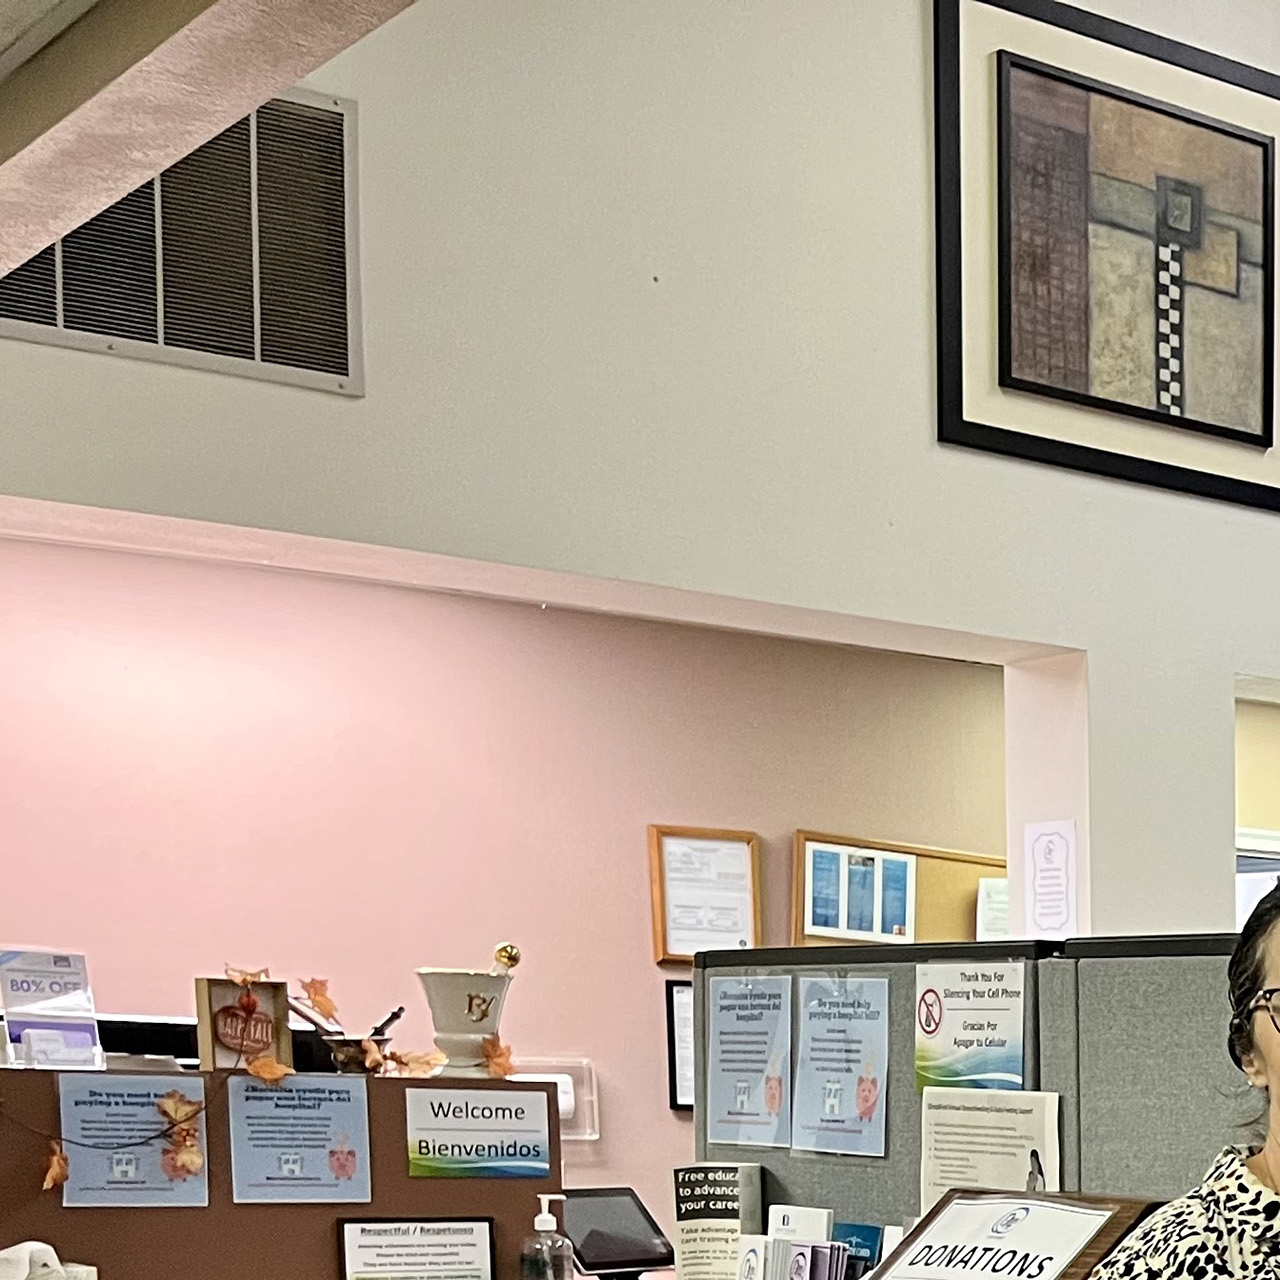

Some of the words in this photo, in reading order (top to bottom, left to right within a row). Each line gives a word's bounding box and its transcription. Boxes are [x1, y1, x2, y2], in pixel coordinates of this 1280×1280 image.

[960, 972, 980, 983] Thank
[980, 972, 993, 983] You
[993, 972, 1005, 983] For
[943, 988, 971, 1001] Silencing
[972, 988, 987, 999] Your
[987, 988, 1000, 999] Cell
[1001, 988, 1021, 999] Phone
[962, 1020, 985, 1032] Gracias
[986, 1021, 998, 1031] Por
[984, 1037, 1007, 1048] Celular
[430, 1101, 526, 1120] Welcome
[418, 1139, 541, 1158] Bienvenidos
[678, 1170, 704, 1183] Free
[679, 1186, 692, 1198] to
[693, 1185, 740, 1197] advance
[679, 1201, 709, 1214] your
[360, 1226, 410, 1237] Respectful
[680, 1227, 699, 1235] Take
[700, 1225, 739, 1236] advantage
[681, 1237, 698, 1245] care
[699, 1235, 730, 1245] training
[909, 1244, 1055, 1280] DONATIONS
